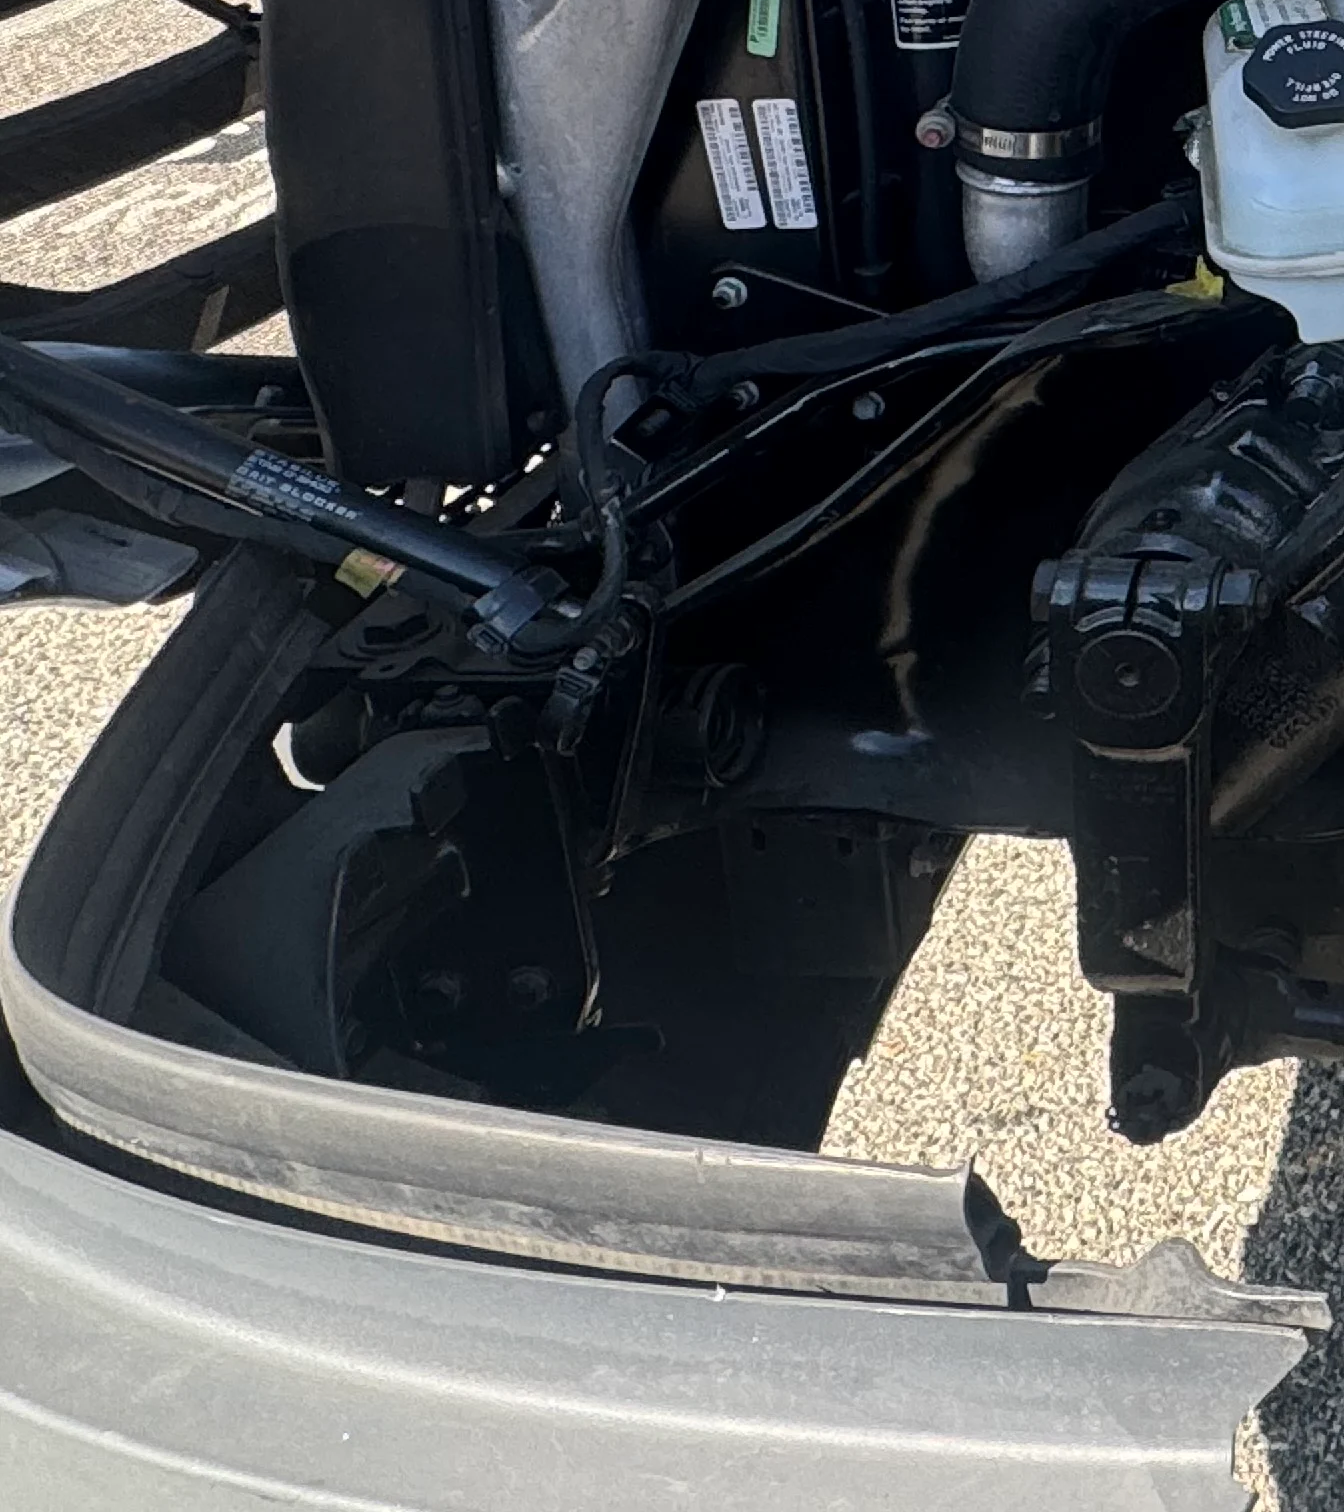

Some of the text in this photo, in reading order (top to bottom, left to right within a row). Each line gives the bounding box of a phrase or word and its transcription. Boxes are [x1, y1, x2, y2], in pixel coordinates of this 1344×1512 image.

[1262, 34, 1295, 63] POWER
[1286, 40, 1328, 55] FLUID
[1285, 71, 1342, 93] OVERFILL
[1292, 87, 1340, 103] DO NOT
